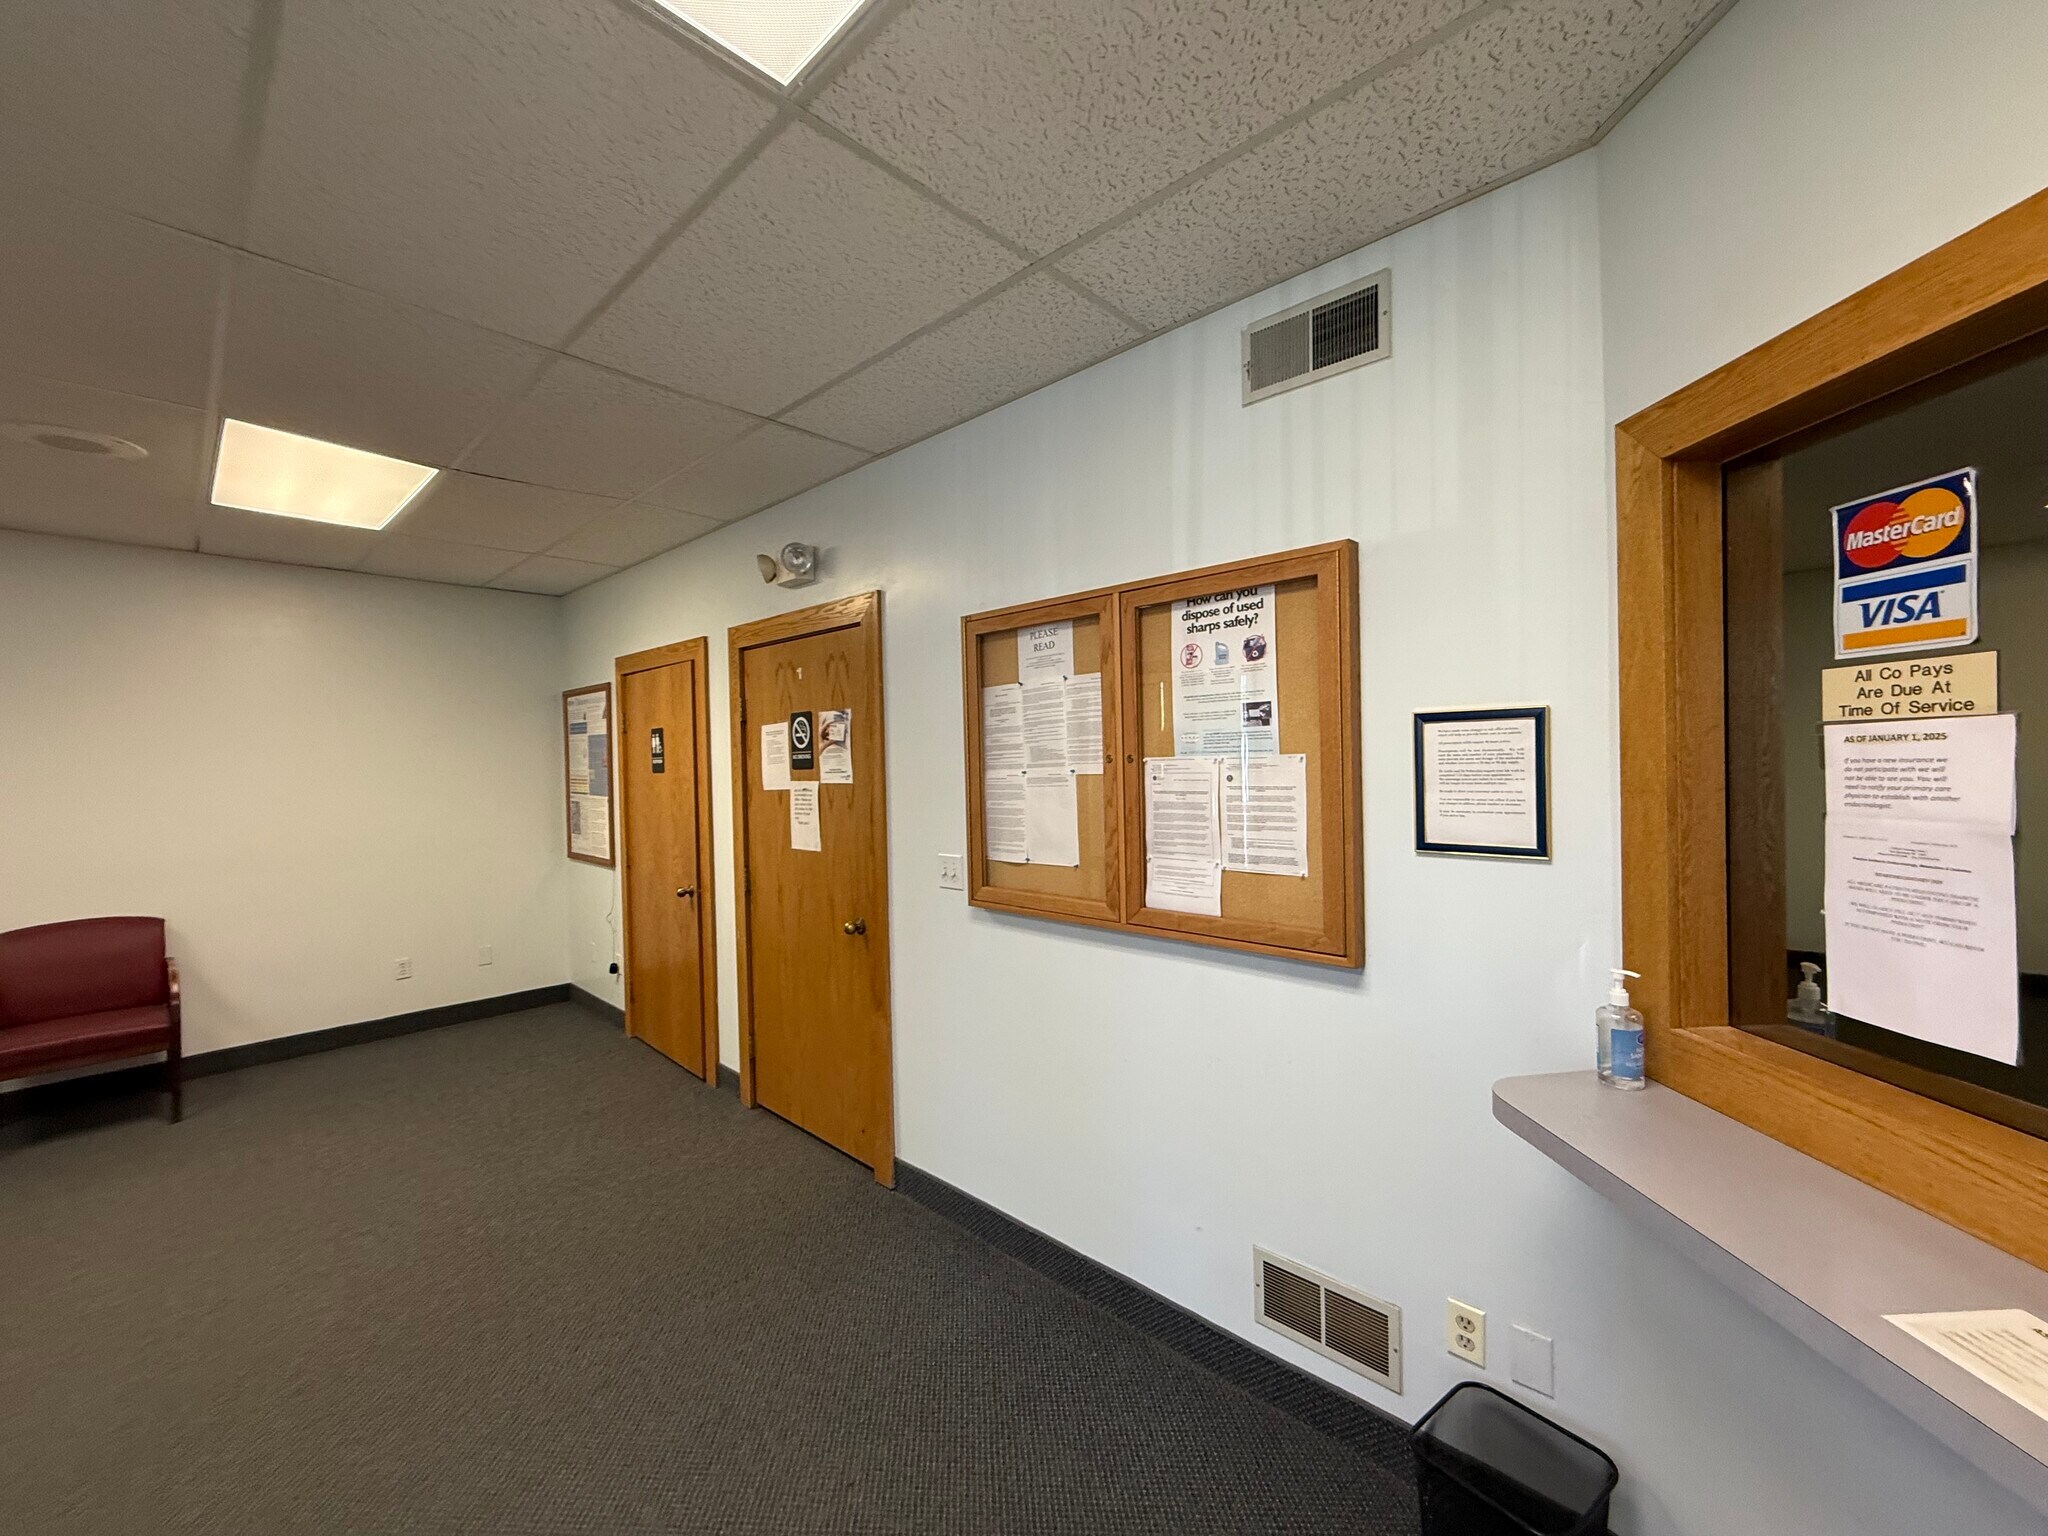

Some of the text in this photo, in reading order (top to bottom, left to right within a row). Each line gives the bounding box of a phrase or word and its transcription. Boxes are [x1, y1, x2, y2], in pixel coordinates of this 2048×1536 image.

[1845, 506, 1962, 551] MasterCard
[1186, 587, 1258, 607] How can you
[1181, 598, 1264, 622] dispose of used
[1860, 591, 1941, 628] VISA
[1187, 613, 1259, 634] sharps safely?
[1029, 627, 1059, 641] PLEASE
[1033, 640, 1056, 652] READ
[1854, 663, 1953, 683] All Co Pays
[1857, 681, 1951, 700] Are Due At
[1839, 699, 1975, 718] Time Of Service
[1868, 733, 1909, 742] JANUARY
[1911, 733, 1920, 742] 1,
[1922, 733, 1948, 741] 2025
